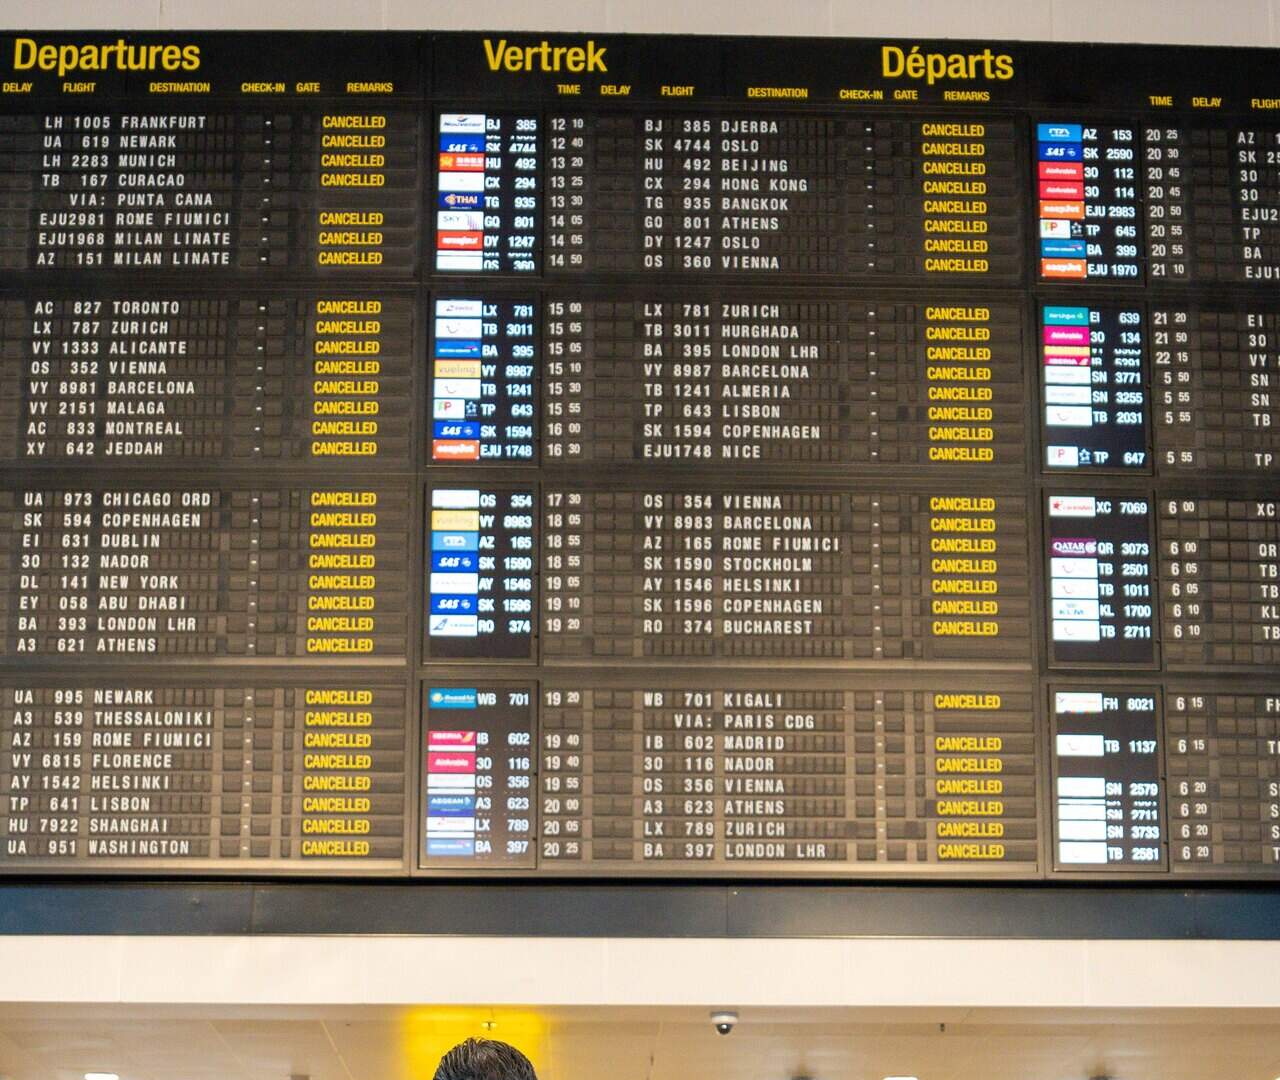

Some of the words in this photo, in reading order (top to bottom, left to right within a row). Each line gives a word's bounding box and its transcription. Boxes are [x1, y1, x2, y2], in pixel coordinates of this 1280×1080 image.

[14, 39, 200, 76] Departures
[484, 40, 607, 72] Vertrek
[883, 46, 1013, 84] Départs
[3, 83, 32, 92] DELAY
[63, 83, 96, 92] FLIGHT
[150, 83, 210, 92] DESTINATION
[242, 83, 285, 92] CHECK-IN
[296, 83, 320, 92] GATE
[347, 83, 393, 92] REMARKS
[558, 85, 580, 94] TIME
[601, 85, 630, 95] DELAY
[662, 86, 694, 96] FLIGHT
[748, 88, 808, 98] DESTINATION
[840, 90, 883, 99] CHECK-IN
[894, 90, 917, 99] GATE
[944, 91, 990, 101] REMARKS
[1150, 96, 1172, 105] TIME
[1193, 97, 1221, 107] DELAY
[45, 117, 62, 128] LH
[75, 117, 110, 128] 1005
[122, 116, 205, 128] FRANKFURT
[323, 116, 385, 128] CANCELLED
[1081, 148, 1098, 158] SK
[1107, 148, 1133, 160] 2590
[1239, 151, 1256, 162] SK
[645, 158, 662, 170] HU
[684, 159, 710, 170] 492
[722, 159, 787, 172] BEIJING
[923, 162, 985, 175] CANCELLED
[646, 197, 663, 208] TG
[684, 197, 710, 209] 935
[722, 198, 788, 210] BANGKOK
[924, 201, 986, 213] CANCELLED
[1243, 228, 1260, 239] TP
[37, 253, 54, 265] AZ
[77, 253, 102, 265] 151
[114, 253, 161, 264] MILAN
[173, 252, 229, 264] LINATE
[319, 252, 382, 264] CANCELLED
[35, 302, 53, 314] AC
[74, 302, 101, 314] 827
[113, 301, 179, 314] TORONTO
[317, 301, 381, 313] CANCELLED
[1249, 354, 1266, 366] VY
[644, 364, 662, 376] VY
[674, 364, 711, 377] 8987
[722, 365, 808, 378] BARCELONA
[927, 367, 991, 380] CANCELLED
[31, 382, 48, 394] VY
[60, 382, 95, 394] 8981
[108, 382, 194, 394] BARCELONA
[314, 381, 378, 394] CANCELLED
[1252, 394, 1269, 406] SN
[645, 404, 662, 416] TP
[684, 404, 711, 417] 643
[723, 405, 779, 418] LISBON
[928, 407, 992, 420] CANCELLED
[24, 513, 41, 526] SK
[64, 514, 91, 526] 594
[103, 514, 200, 527] COPENHAGEN
[311, 513, 376, 526] CANCELLED
[1053, 542, 1084, 551] QATAR
[644, 557, 662, 570] SK
[675, 557, 712, 570] 1590
[724, 558, 811, 571] STOCKHOLM
[932, 559, 996, 573] CANCELLED
[1260, 564, 1277, 577] TB
[21, 576, 38, 588] DL
[62, 576, 87, 588] 141
[100, 576, 128, 589] NEW
[141, 576, 177, 589] YORK
[309, 576, 375, 589] CANCELLED
[1100, 604, 1114, 616] KL
[1124, 605, 1151, 617] 1700
[1262, 606, 1279, 618] KL
[644, 620, 662, 632] RO
[685, 620, 712, 633] 374
[724, 620, 811, 634] BUCHAREST
[933, 621, 998, 635] CANCELLED
[644, 693, 662, 706] WB
[685, 693, 711, 706] 701
[724, 693, 781, 707] KIGALI
[935, 695, 1000, 708] CANCELLED
[14, 712, 32, 725] A3
[55, 712, 82, 725] 539
[95, 712, 210, 725] THESSALONIKI
[306, 712, 372, 726] CANCELLED
[646, 736, 663, 749] IB
[685, 736, 713, 749] 602
[724, 736, 783, 750] MADRID
[936, 737, 1001, 750] CANCELLED
[9, 819, 27, 832] HU
[41, 819, 78, 832] 7922
[90, 819, 167, 832] SHANGHAI
[303, 819, 369, 833] CANCELLED
